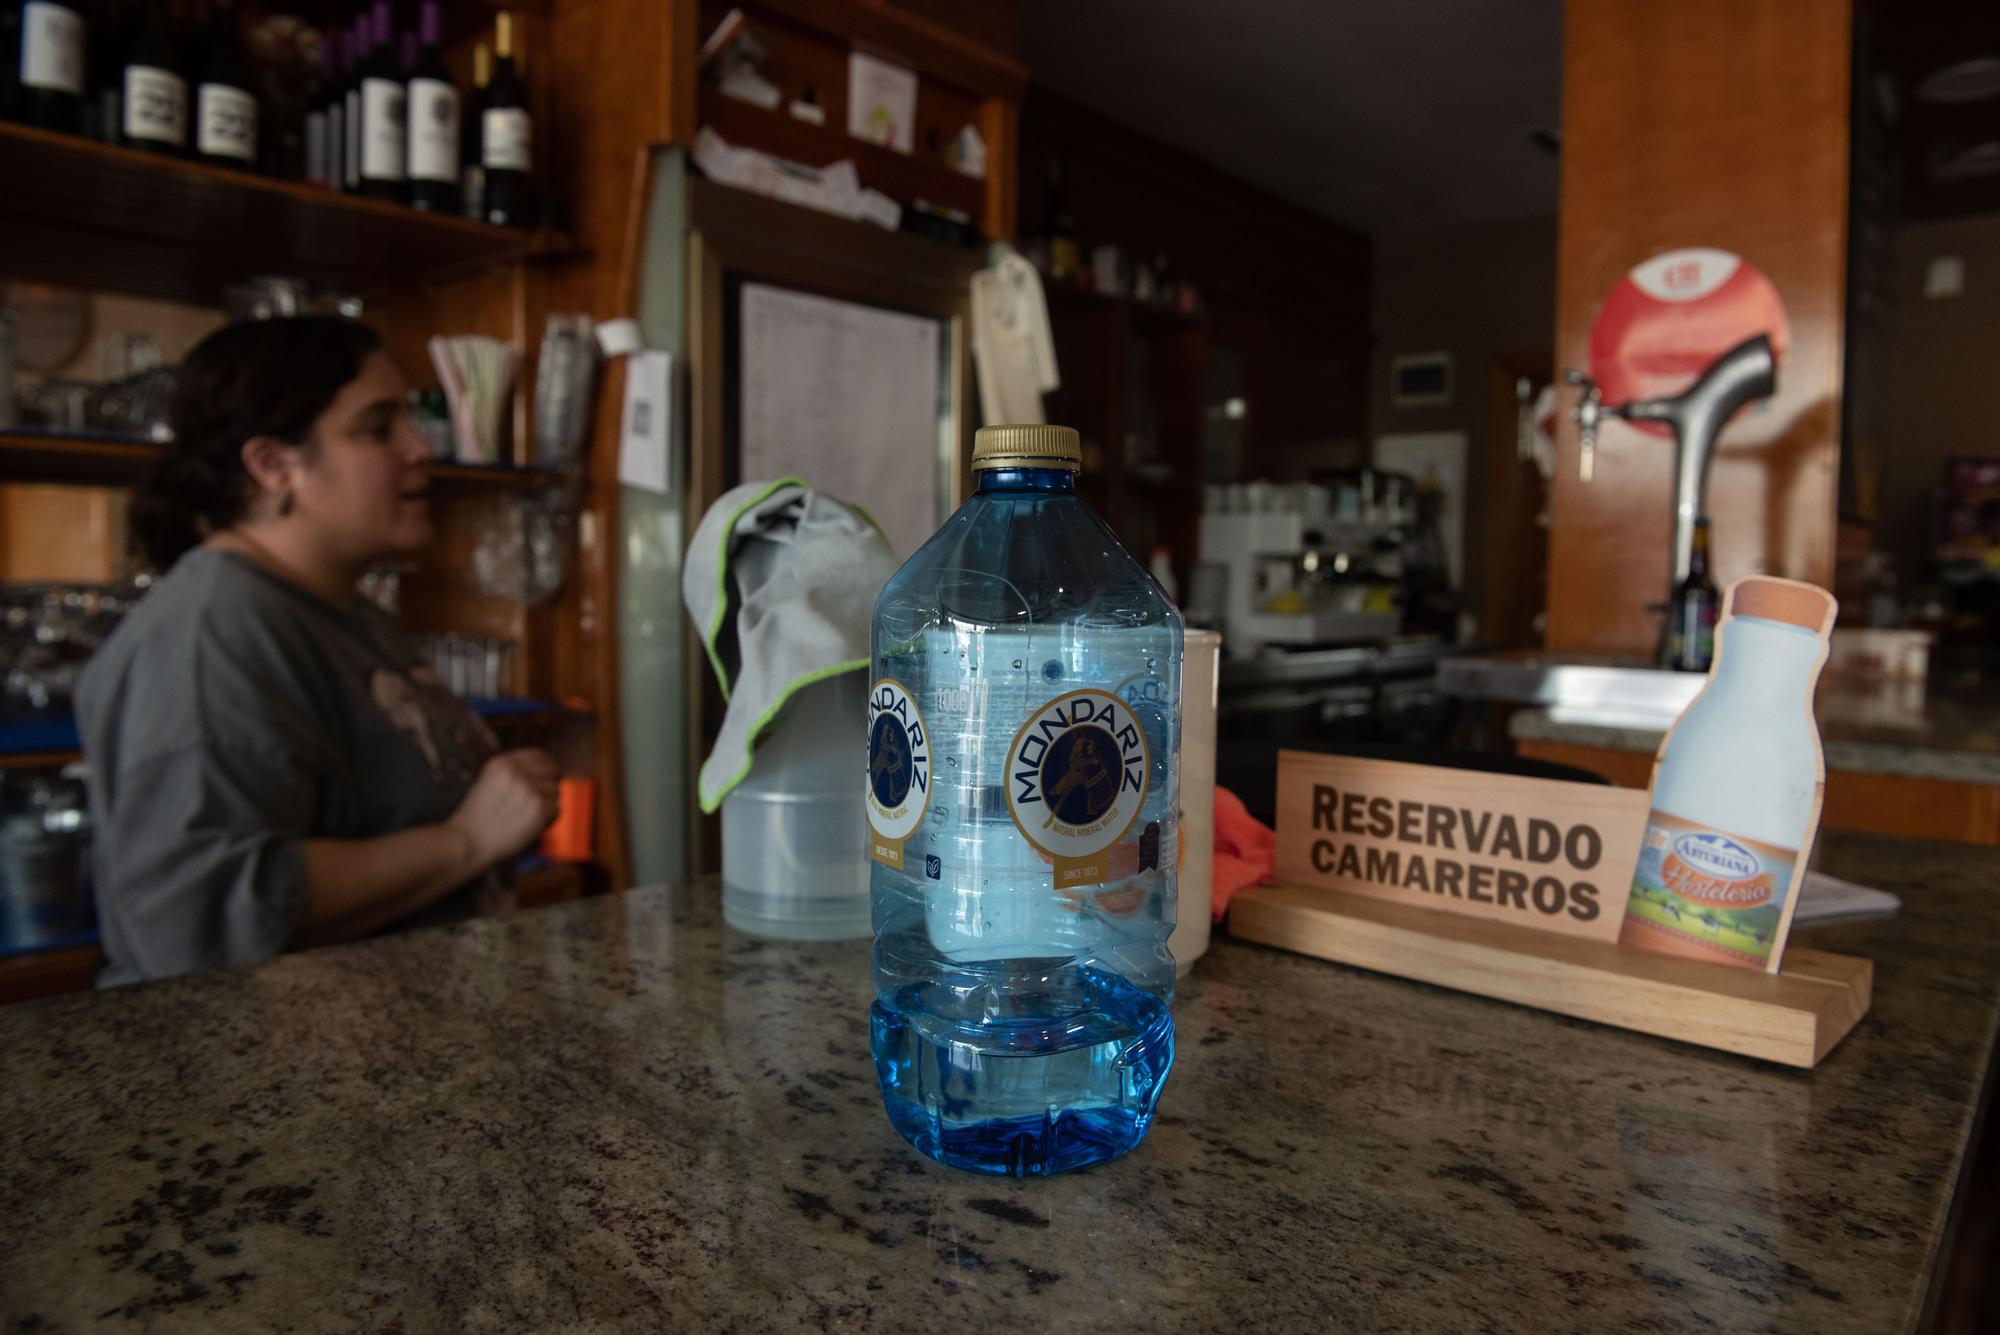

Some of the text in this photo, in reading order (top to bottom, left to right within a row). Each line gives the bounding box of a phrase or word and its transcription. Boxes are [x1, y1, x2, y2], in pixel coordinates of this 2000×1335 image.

[866, 687, 927, 794] NDARIZ
[1015, 698, 1142, 803] MONDARIZ
[1102, 808, 1120, 827] WATER
[1312, 783, 1603, 871] RESERVADO
[1681, 840, 1751, 875] ASTURIANA
[1063, 866, 1098, 880] SINCE 1873
[1310, 838, 1601, 922] CAMAREROS
